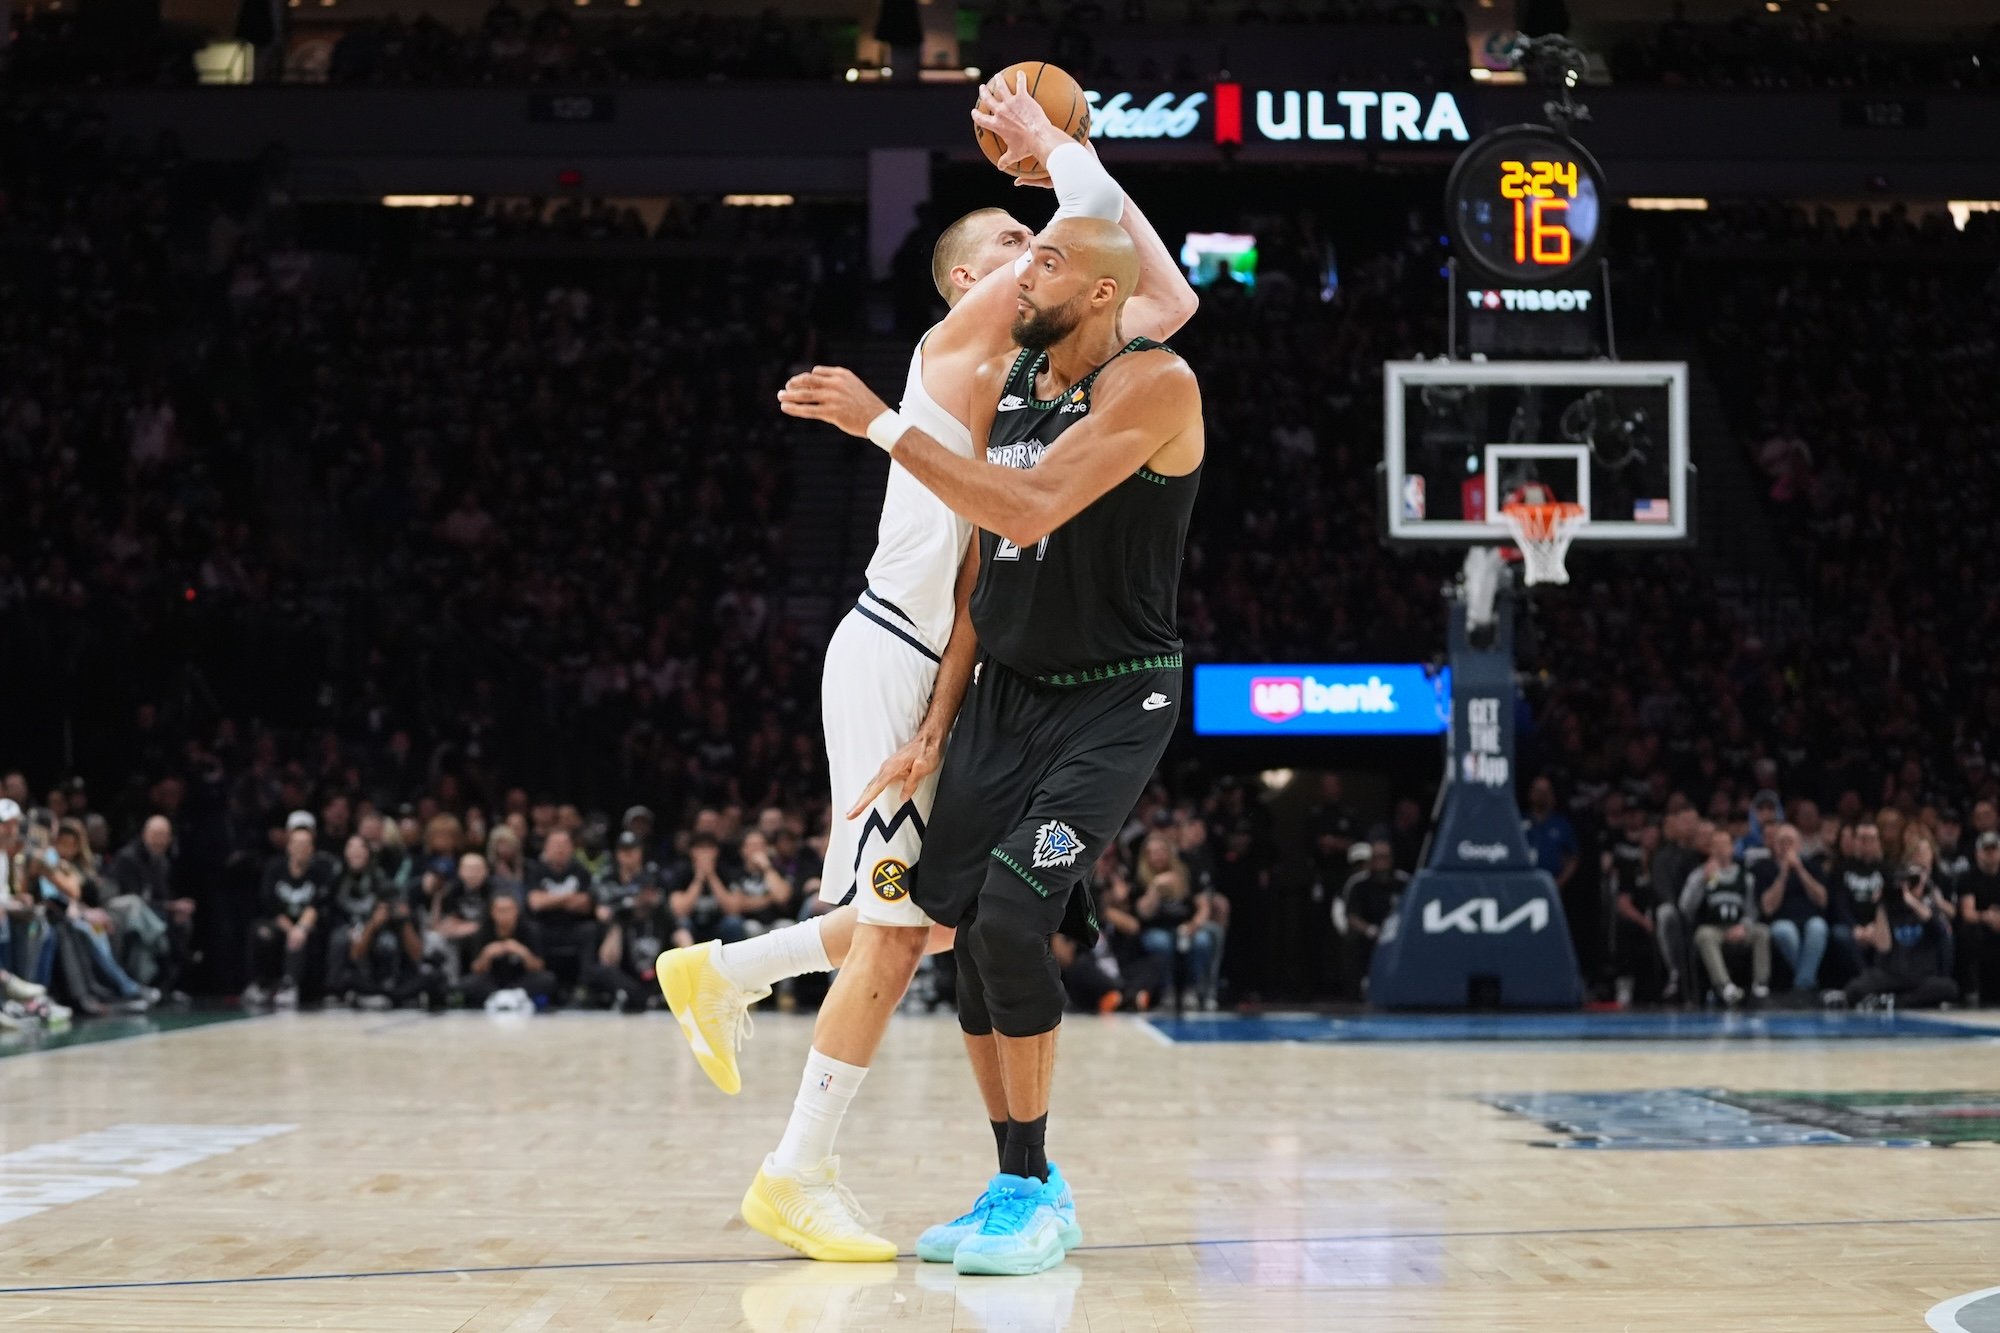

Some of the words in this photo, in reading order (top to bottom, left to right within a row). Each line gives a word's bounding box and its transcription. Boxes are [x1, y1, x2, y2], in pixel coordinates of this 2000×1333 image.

[1256, 90, 1471, 141] ULTRA
[1501, 160, 1577, 198] 2:24
[1514, 198, 1572, 264] 16
[1501, 288, 1592, 311] TISSOT
[1302, 676, 1396, 713] bank
